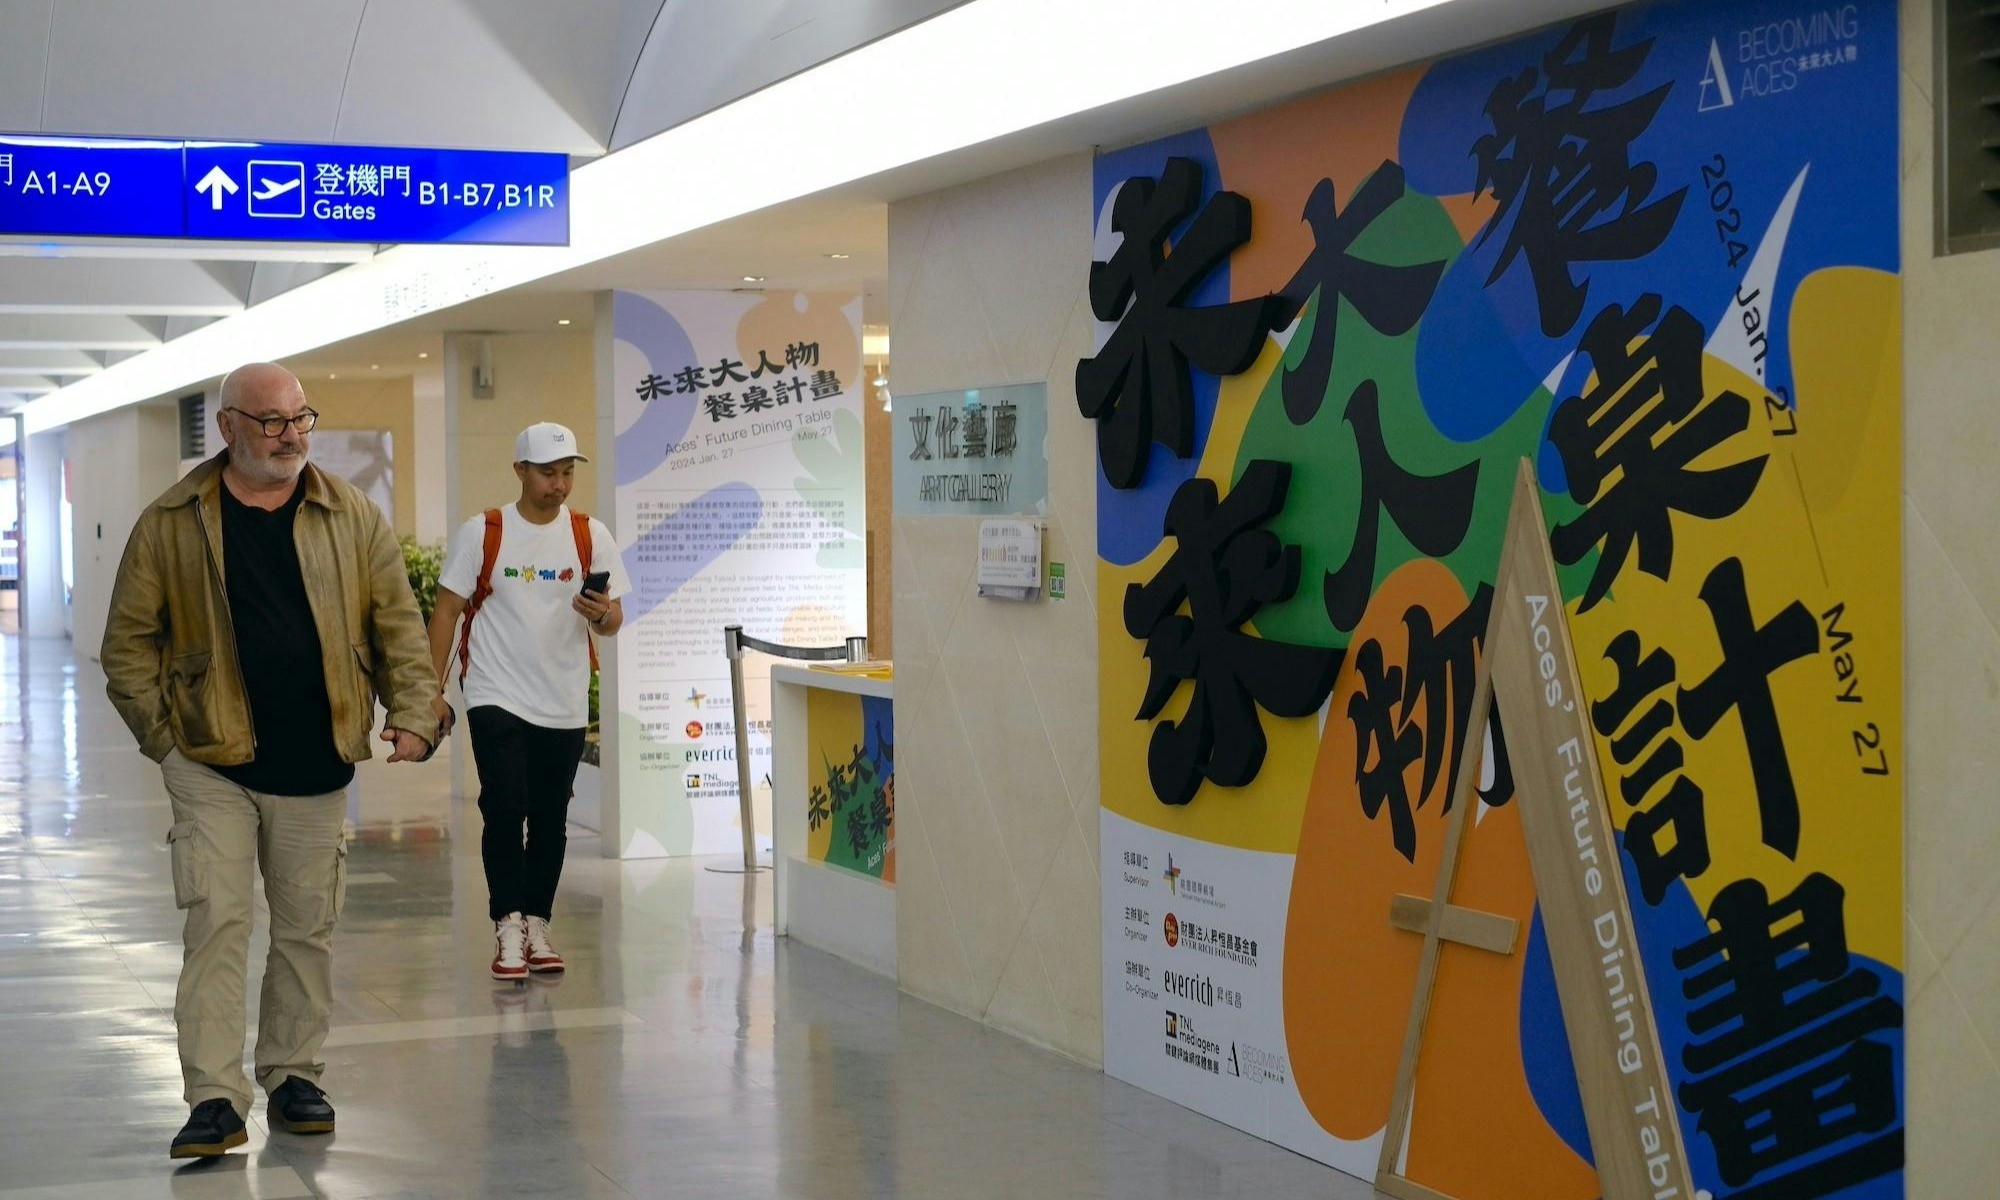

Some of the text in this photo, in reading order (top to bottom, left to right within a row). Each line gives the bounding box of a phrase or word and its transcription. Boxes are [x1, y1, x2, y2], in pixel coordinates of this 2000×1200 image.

[1739, 5, 1857, 63] BECOMING
[1740, 56, 1797, 101] ACES
[22, 170, 111, 196] A1-A9
[314, 162, 411, 197] 登機門
[419, 181, 555, 210] B1-B7,B1R
[313, 200, 376, 221] Gates
[636, 341, 820, 402] 未來大人物
[703, 369, 844, 423] 餐桌計畫
[706, 428, 748, 446] Future
[752, 418, 793, 437] Dining
[796, 409, 832, 425] Table
[908, 400, 1017, 461] 文化藝廊
[669, 456, 697, 471] 2024
[722, 448, 735, 460] 27
[798, 428, 820, 442] May
[820, 425, 833, 437] 27
[1700, 152, 1891, 779] 2024 Jan. 27 May 27
[1557, 735, 1604, 896] Future
[1594, 906, 1644, 1077] Dining
[1164, 970, 1213, 1008] everrich
[1179, 1014, 1194, 1033] TNL
[1179, 1031, 1220, 1056] mediagene
[1242, 1043, 1286, 1074] BECOMING
[1242, 1063, 1264, 1085] ACES
